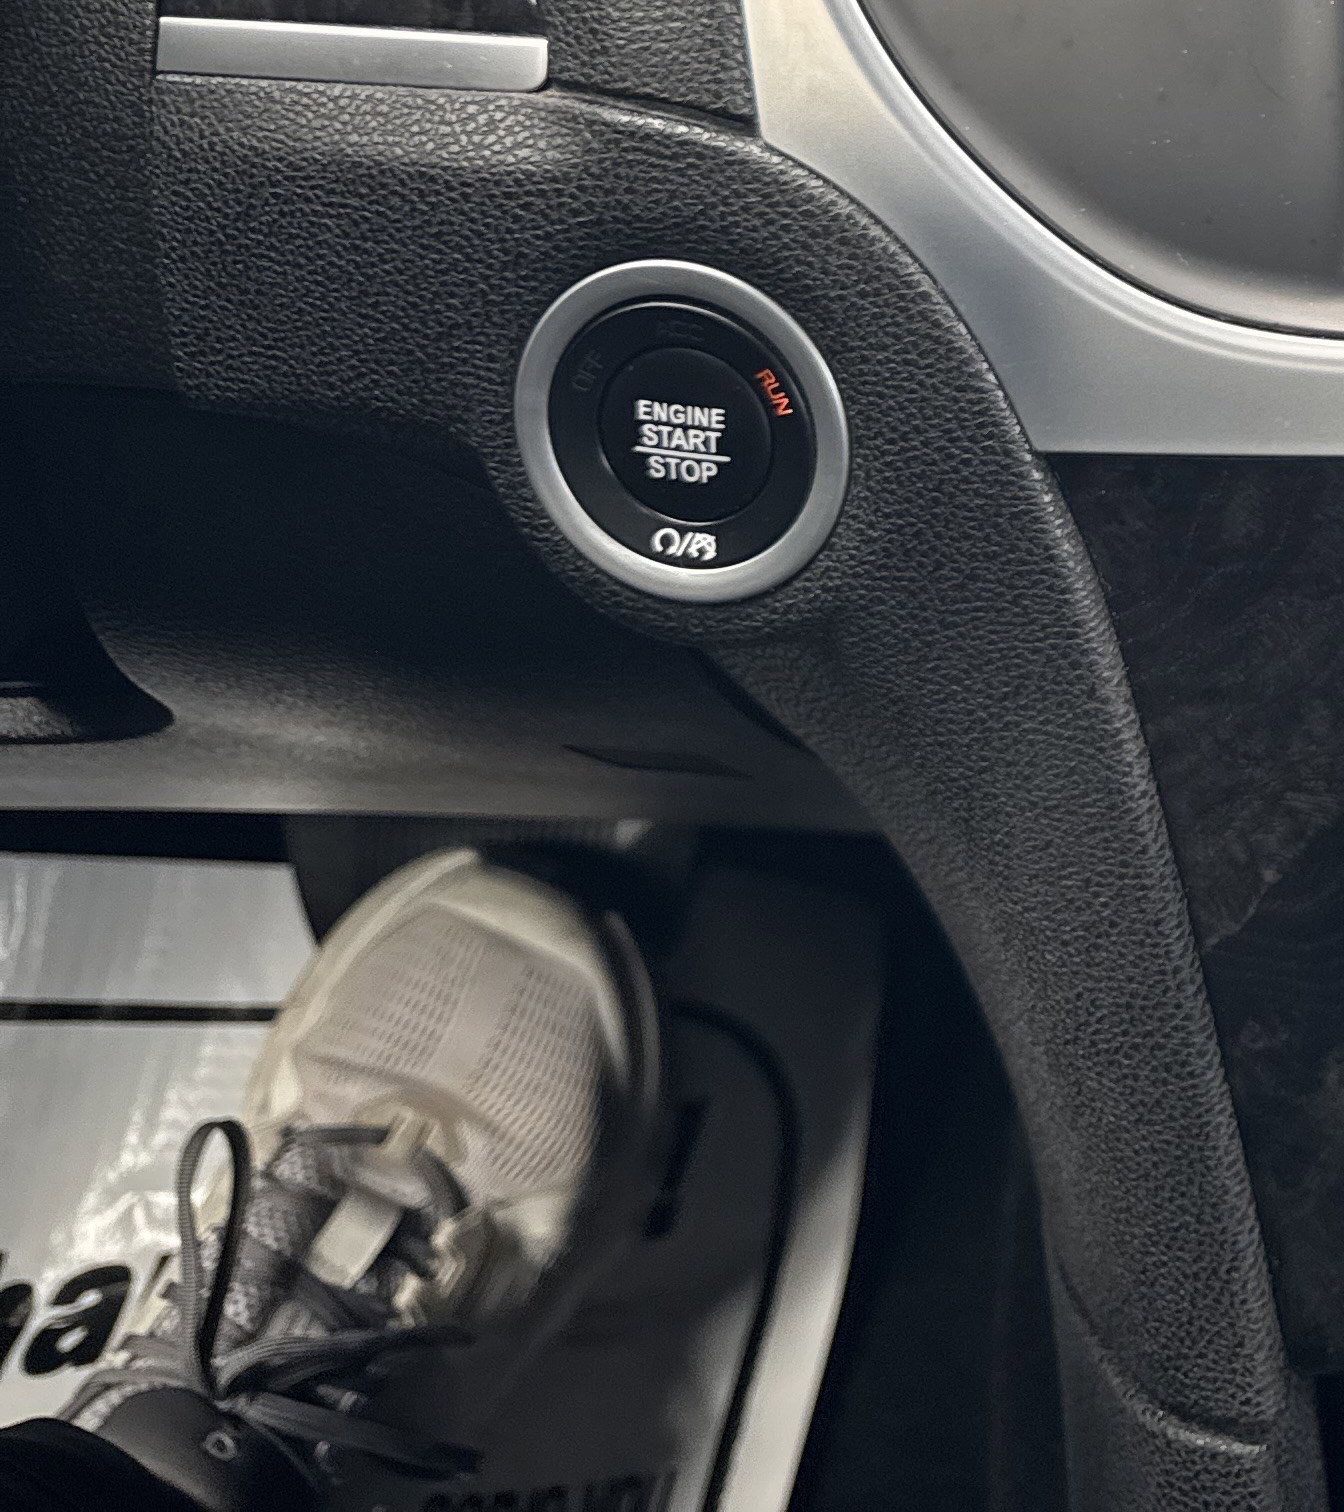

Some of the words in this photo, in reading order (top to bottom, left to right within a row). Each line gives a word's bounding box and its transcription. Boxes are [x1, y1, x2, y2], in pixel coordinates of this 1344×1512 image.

[754, 368, 794, 418] RUN
[634, 399, 726, 430] ENGINE
[640, 423, 722, 455] START
[647, 454, 718, 485] STOP
